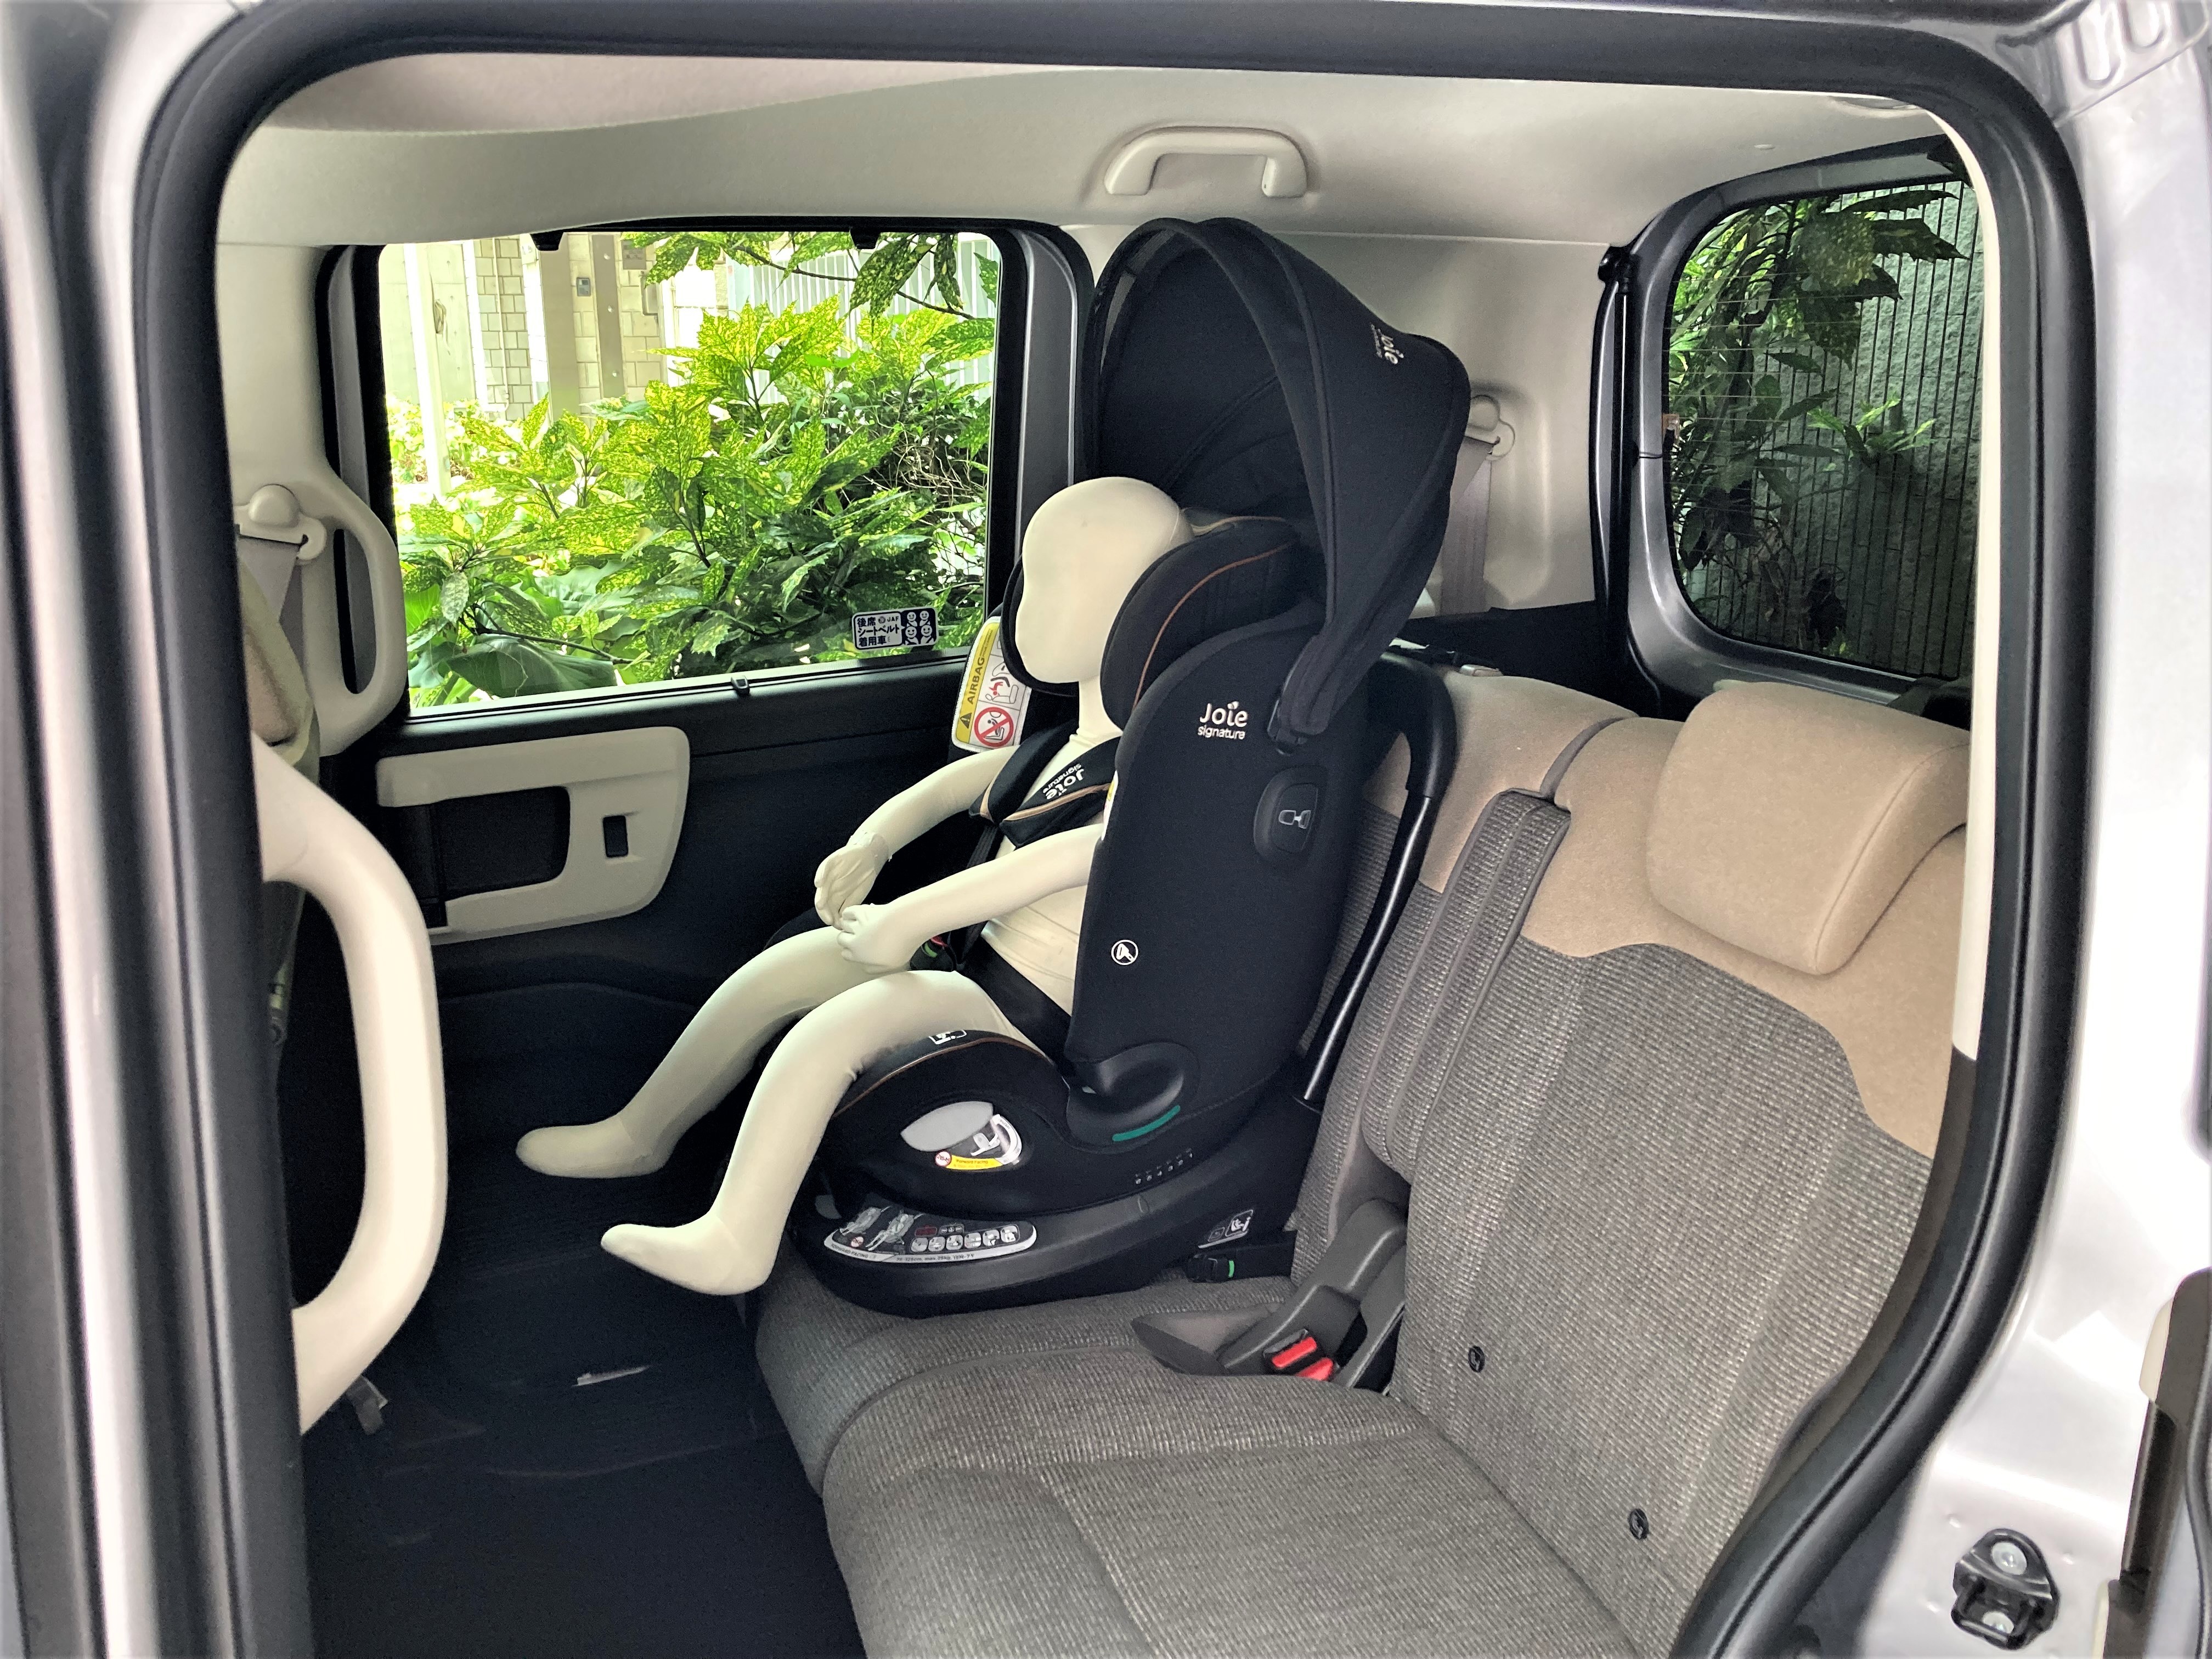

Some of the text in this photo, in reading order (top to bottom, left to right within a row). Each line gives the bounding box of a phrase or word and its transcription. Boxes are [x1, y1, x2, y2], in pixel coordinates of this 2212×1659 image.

[857, 617, 876, 627] 後席
[857, 624, 899, 637] シートベルト
[859, 635, 887, 647] 着用車
[967, 657, 985, 704] AIRBAG
[1199, 701, 1248, 727] Joie
[1197, 724, 1246, 740] signature
[1045, 769, 1085, 799] Joie
